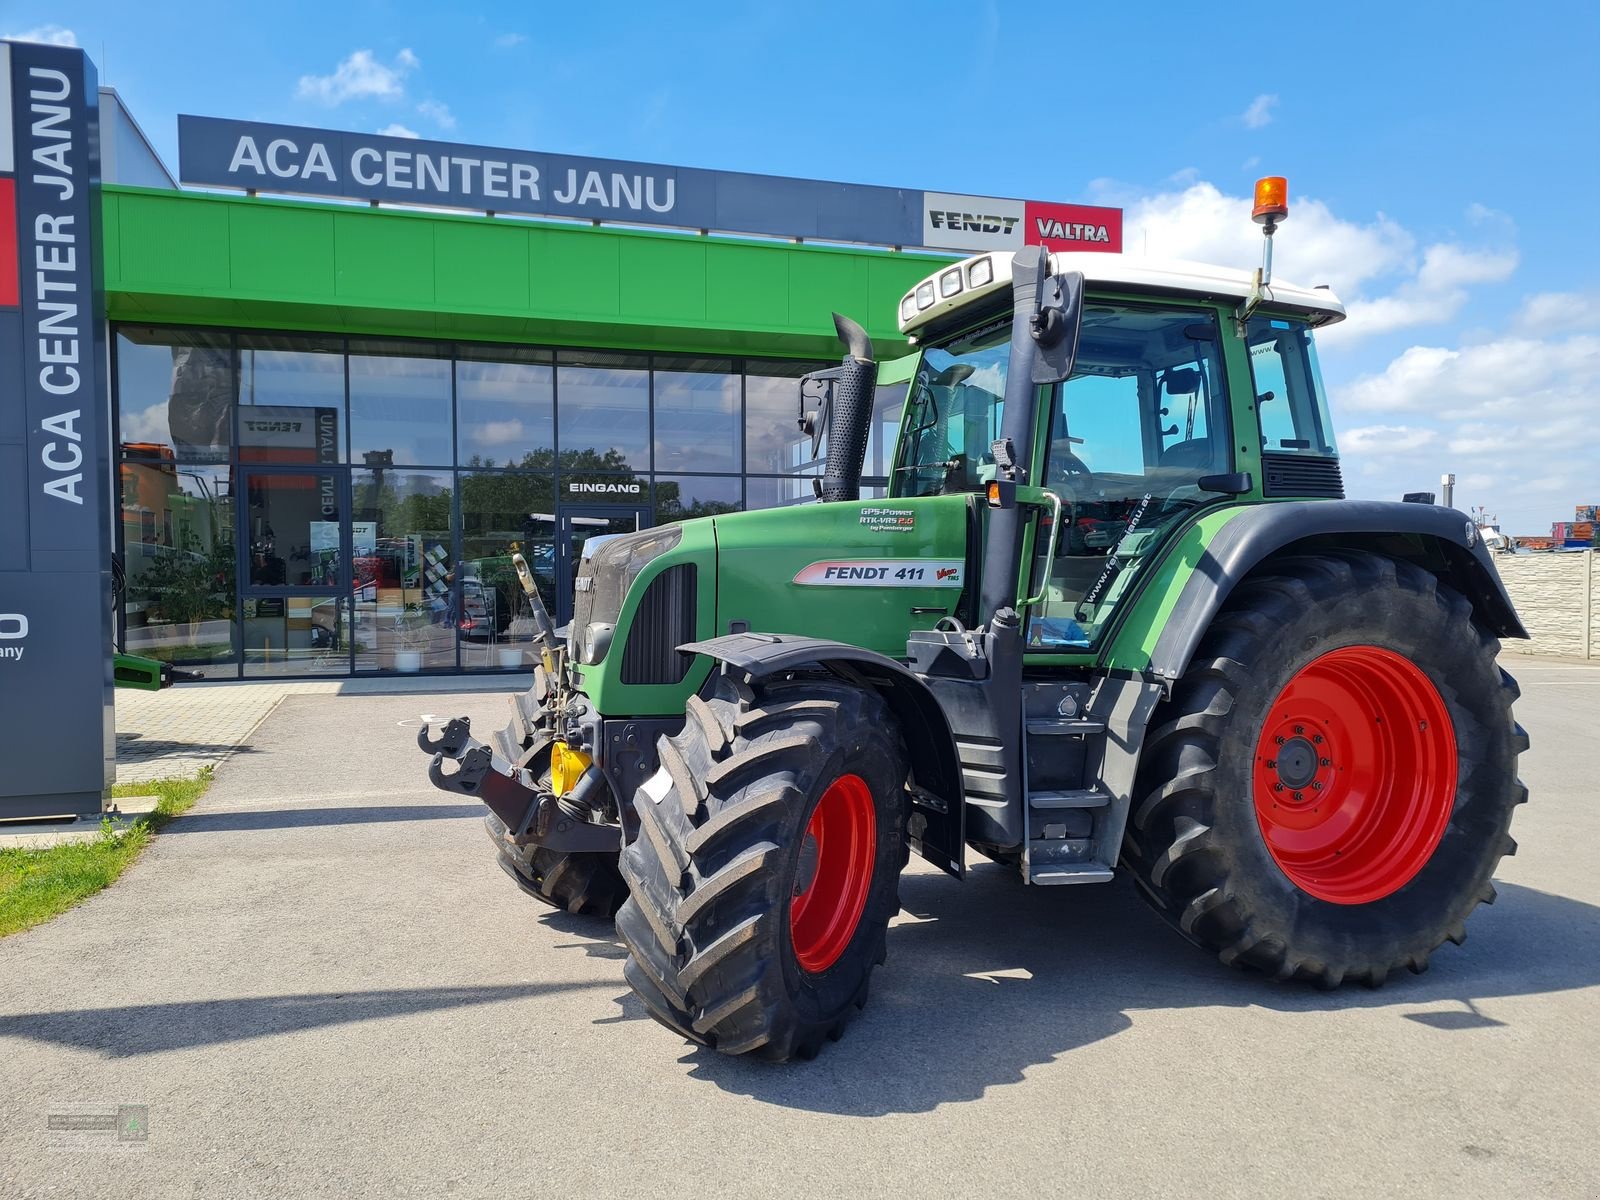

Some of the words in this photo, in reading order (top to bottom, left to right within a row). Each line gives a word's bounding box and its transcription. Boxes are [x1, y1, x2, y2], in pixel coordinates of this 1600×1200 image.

[29, 67, 74, 200] JANU
[228, 135, 337, 182] ACA
[350, 147, 541, 200] CENTER
[553, 168, 675, 213] JANU
[929, 210, 1019, 235] FENDT
[1035, 217, 1109, 243] VALTRA
[35, 213, 80, 394] CENTER
[41, 409, 83, 505] ACA
[569, 483, 640, 493] EINGANG
[861, 508, 914, 516] GPS-Power
[824, 566, 890, 580] FENDT
[894, 567, 925, 580] 411
